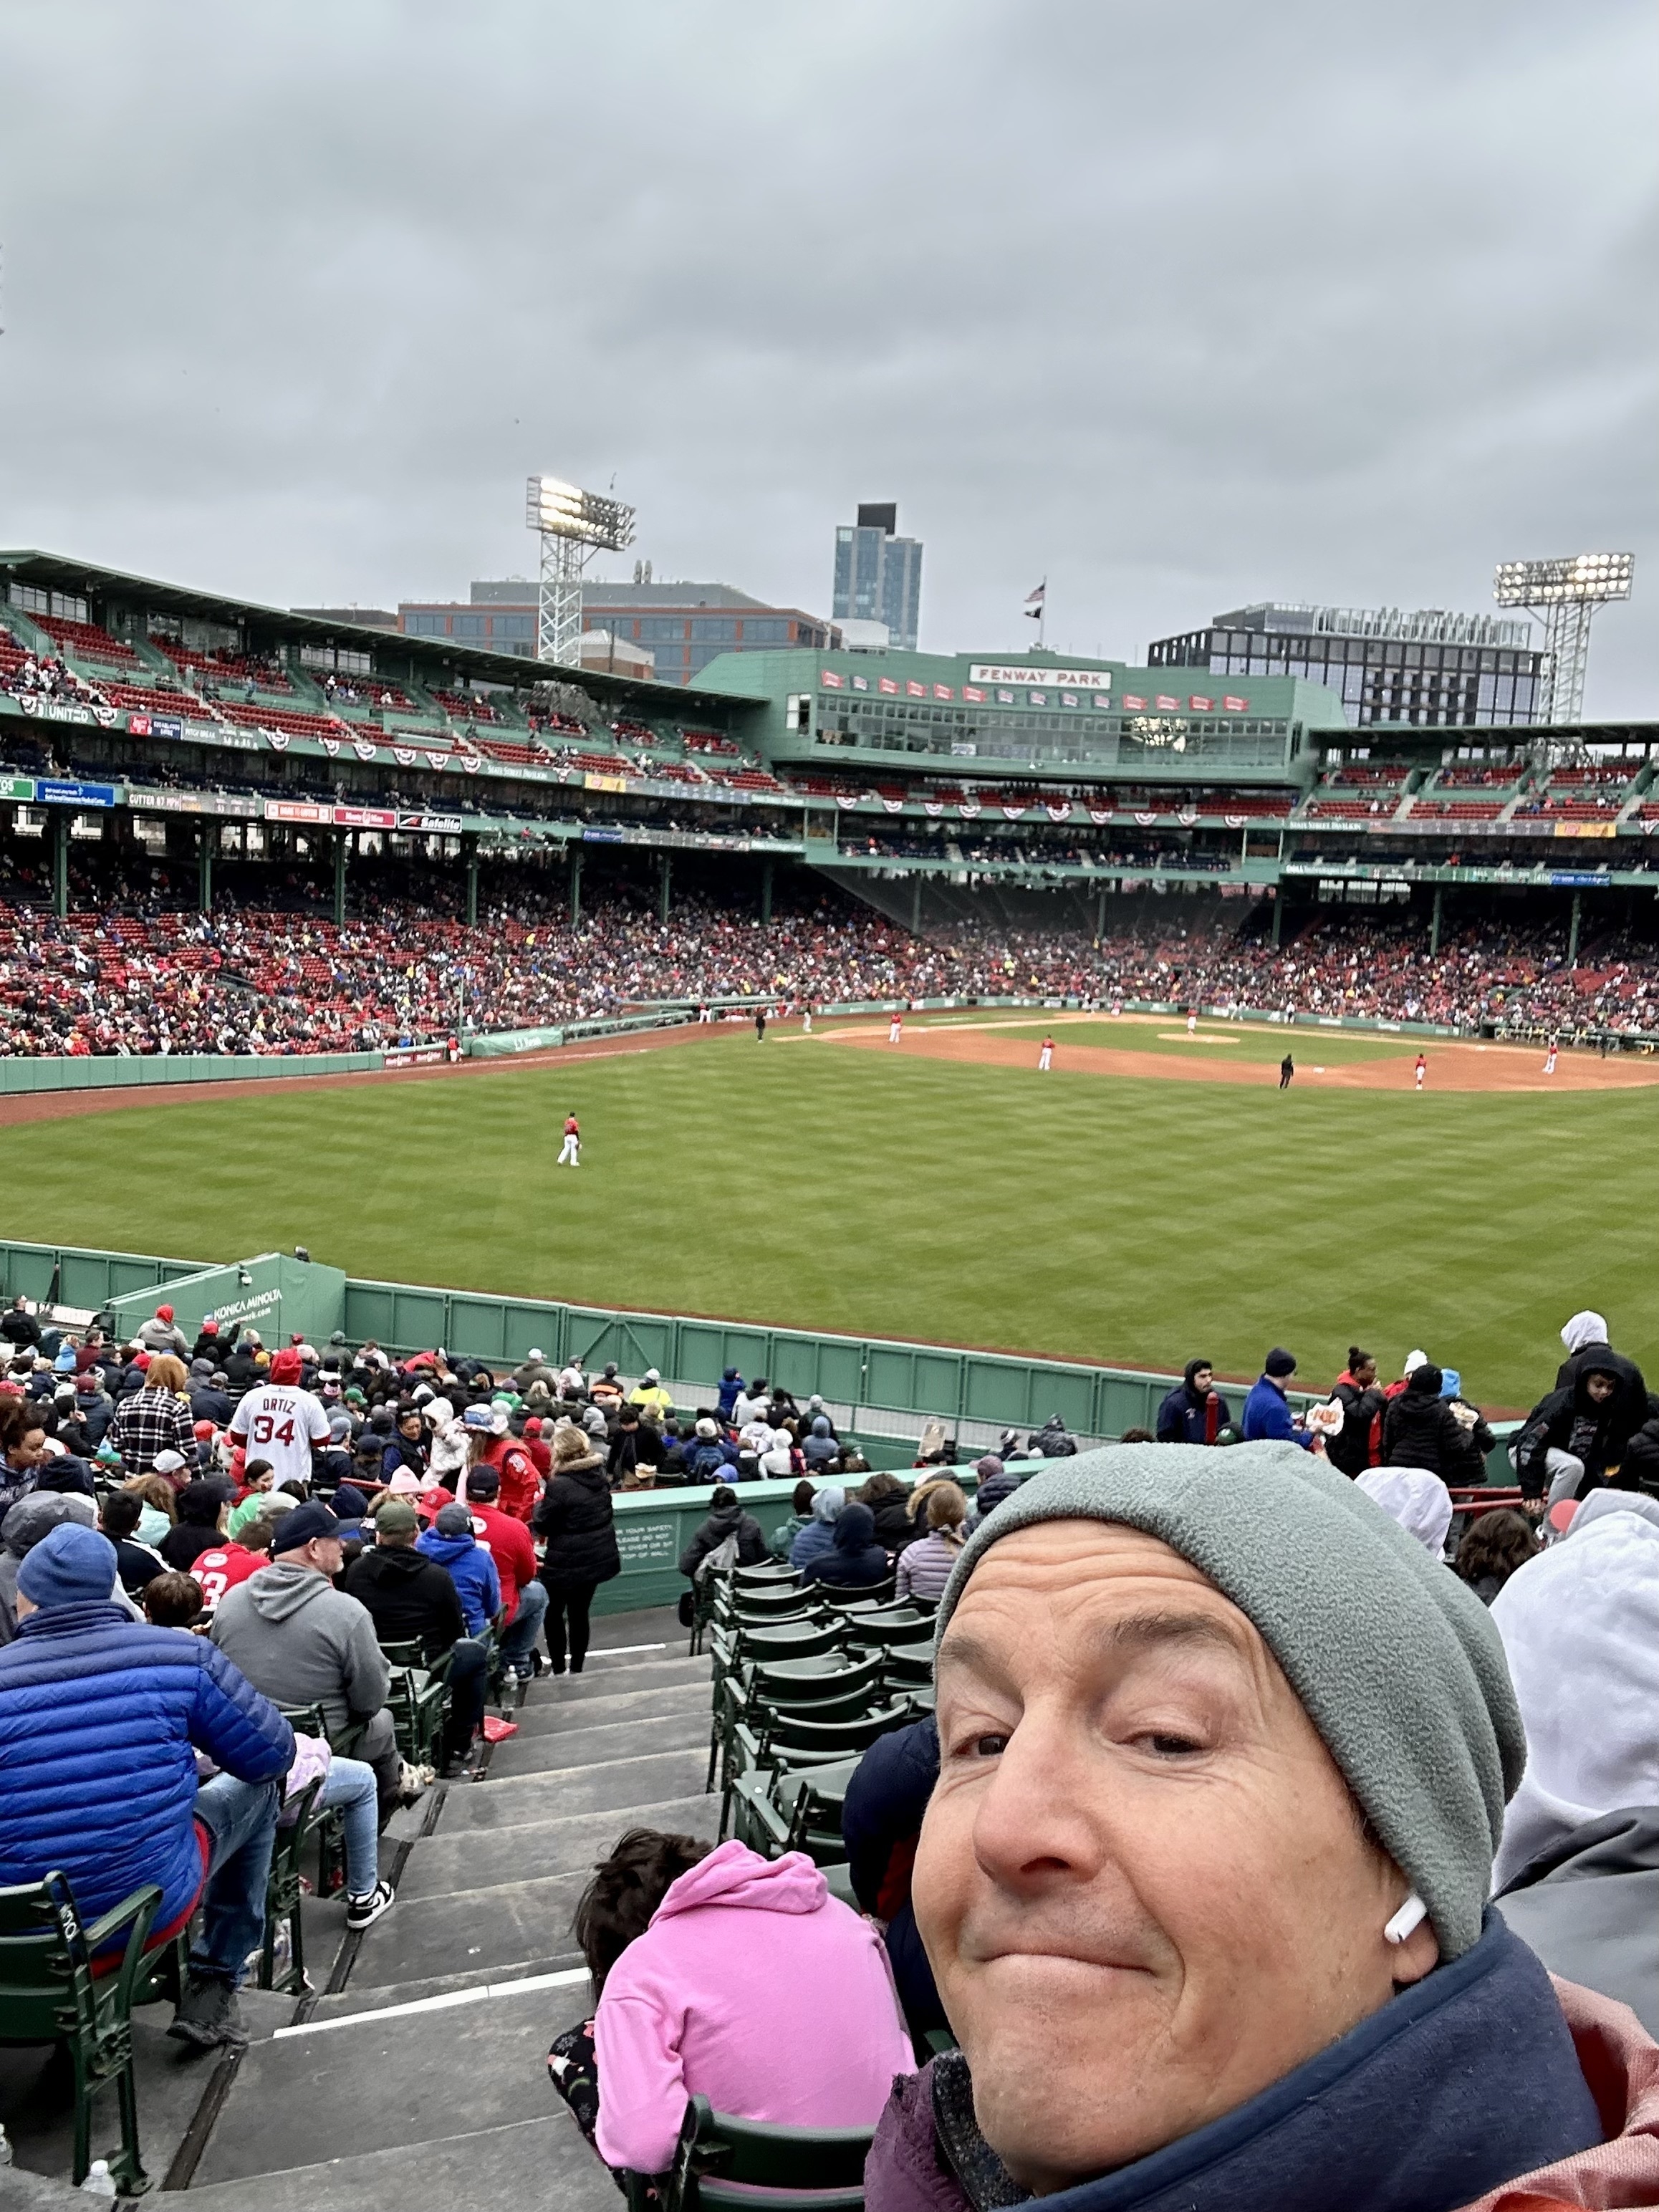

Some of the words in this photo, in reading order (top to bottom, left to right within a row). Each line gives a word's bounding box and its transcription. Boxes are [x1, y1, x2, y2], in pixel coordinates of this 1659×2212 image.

[979, 668, 1047, 682] FENWAY
[1056, 673, 1101, 686] PARK
[49, 703, 89, 723] UNITED
[504, 766, 522, 778] STREET
[523, 768, 548, 779] PAVILION
[129, 794, 155, 806] CUTTER
[420, 816, 460, 830] Safelite
[1308, 821, 1330, 830] STREET
[1331, 822, 1362, 831] PAVILION
[213, 1301, 246, 1320] KONICA
[246, 1289, 283, 1309] MINOLTA
[263, 1398, 297, 1414] ORTIZ
[254, 1415, 295, 1446] 34
